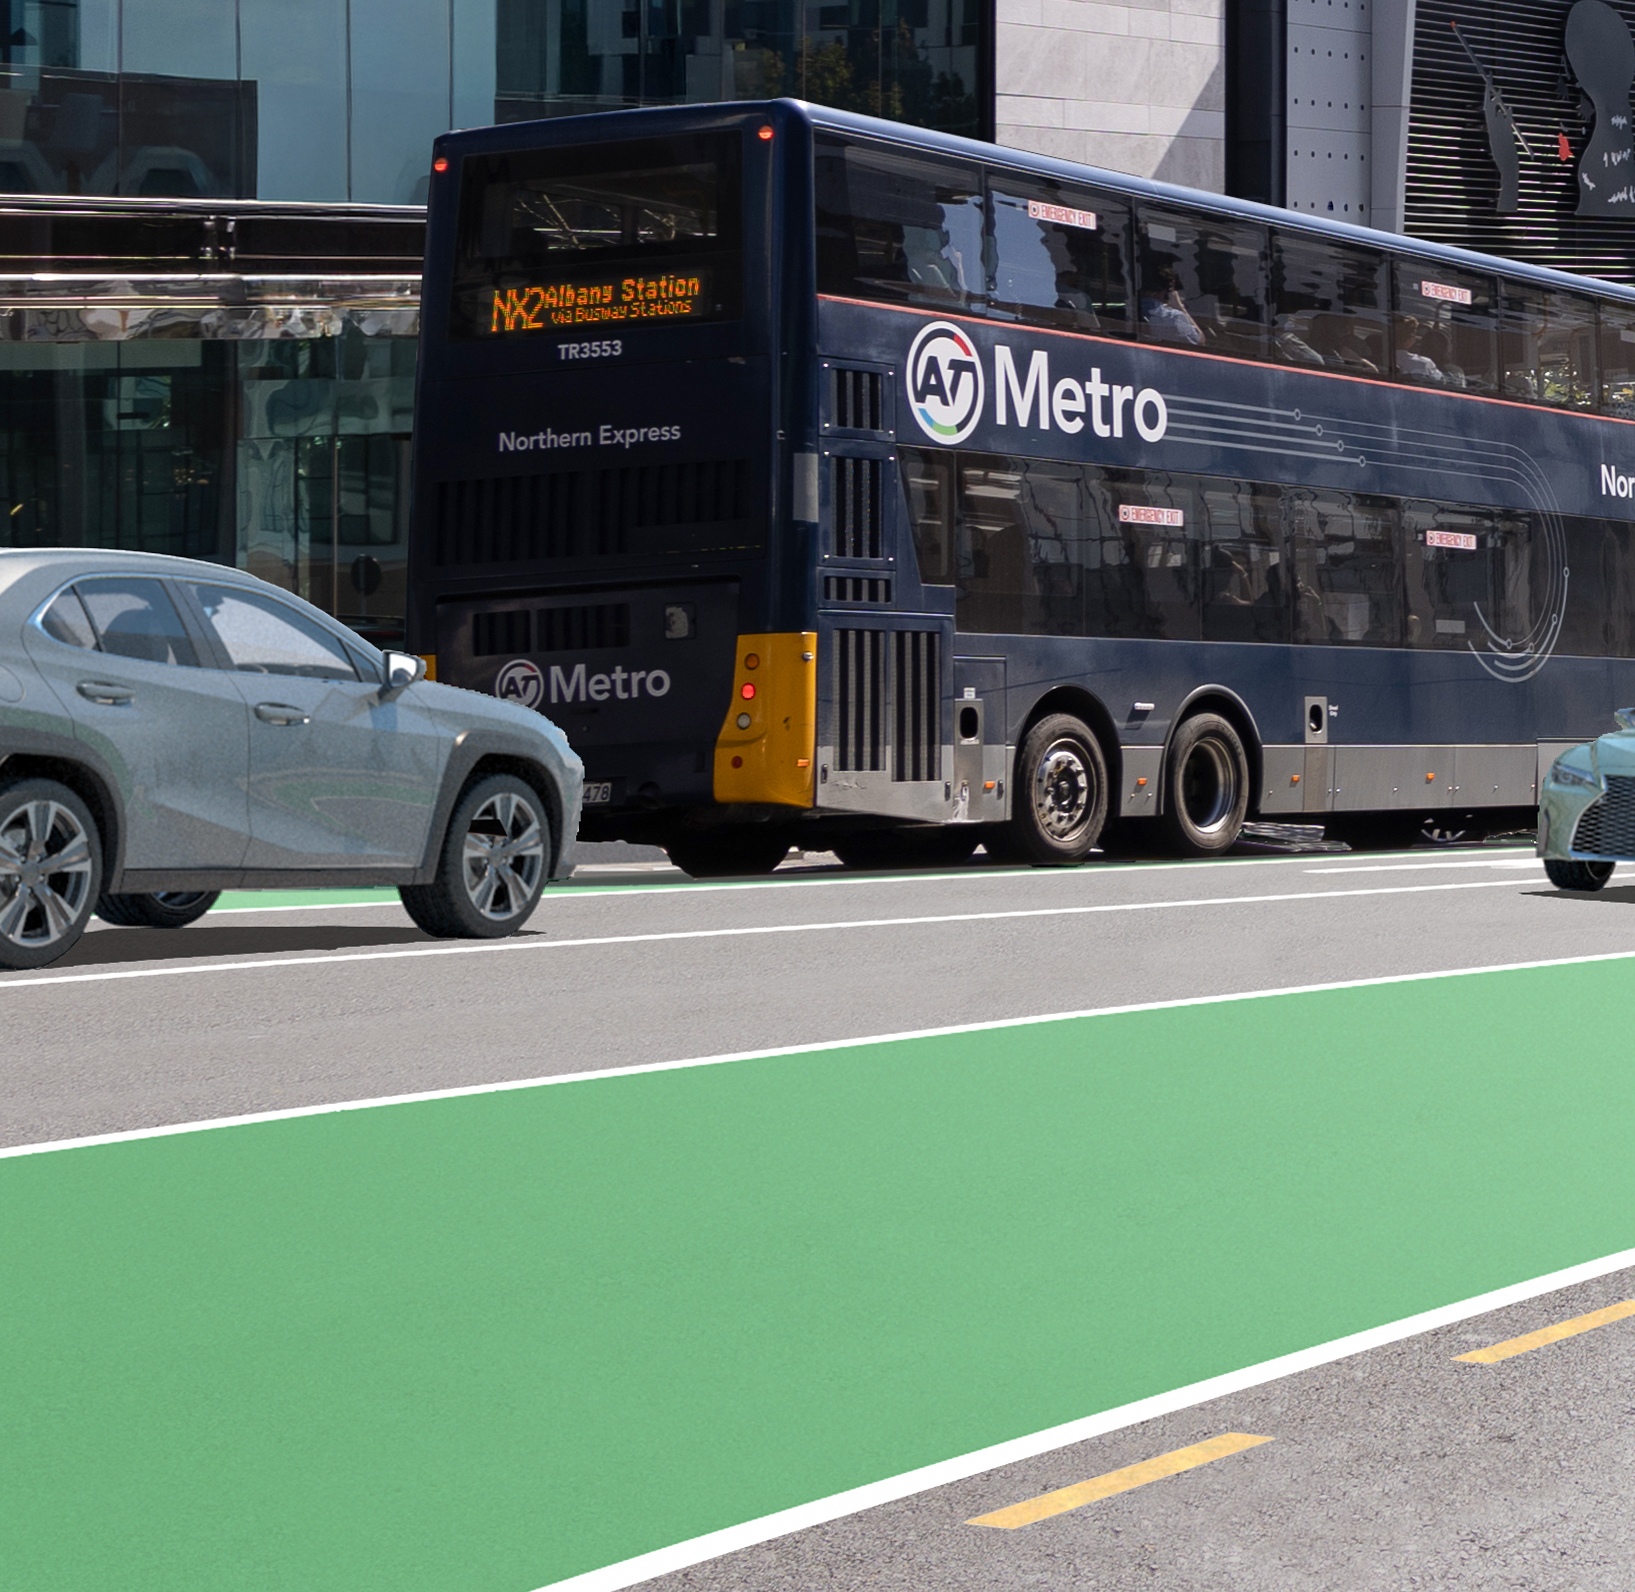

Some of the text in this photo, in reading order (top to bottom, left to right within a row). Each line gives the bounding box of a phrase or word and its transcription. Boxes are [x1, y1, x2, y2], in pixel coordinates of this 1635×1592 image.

[545, 274, 699, 308] Albany Station
[491, 286, 544, 332] NX2
[551, 299, 692, 324] via Busway Stations
[558, 339, 622, 359] TR3553
[994, 344, 1168, 443] Metro
[499, 424, 681, 452] Northern Express
[551, 663, 671, 703] Metro
[582, 784, 610, 802] 478
